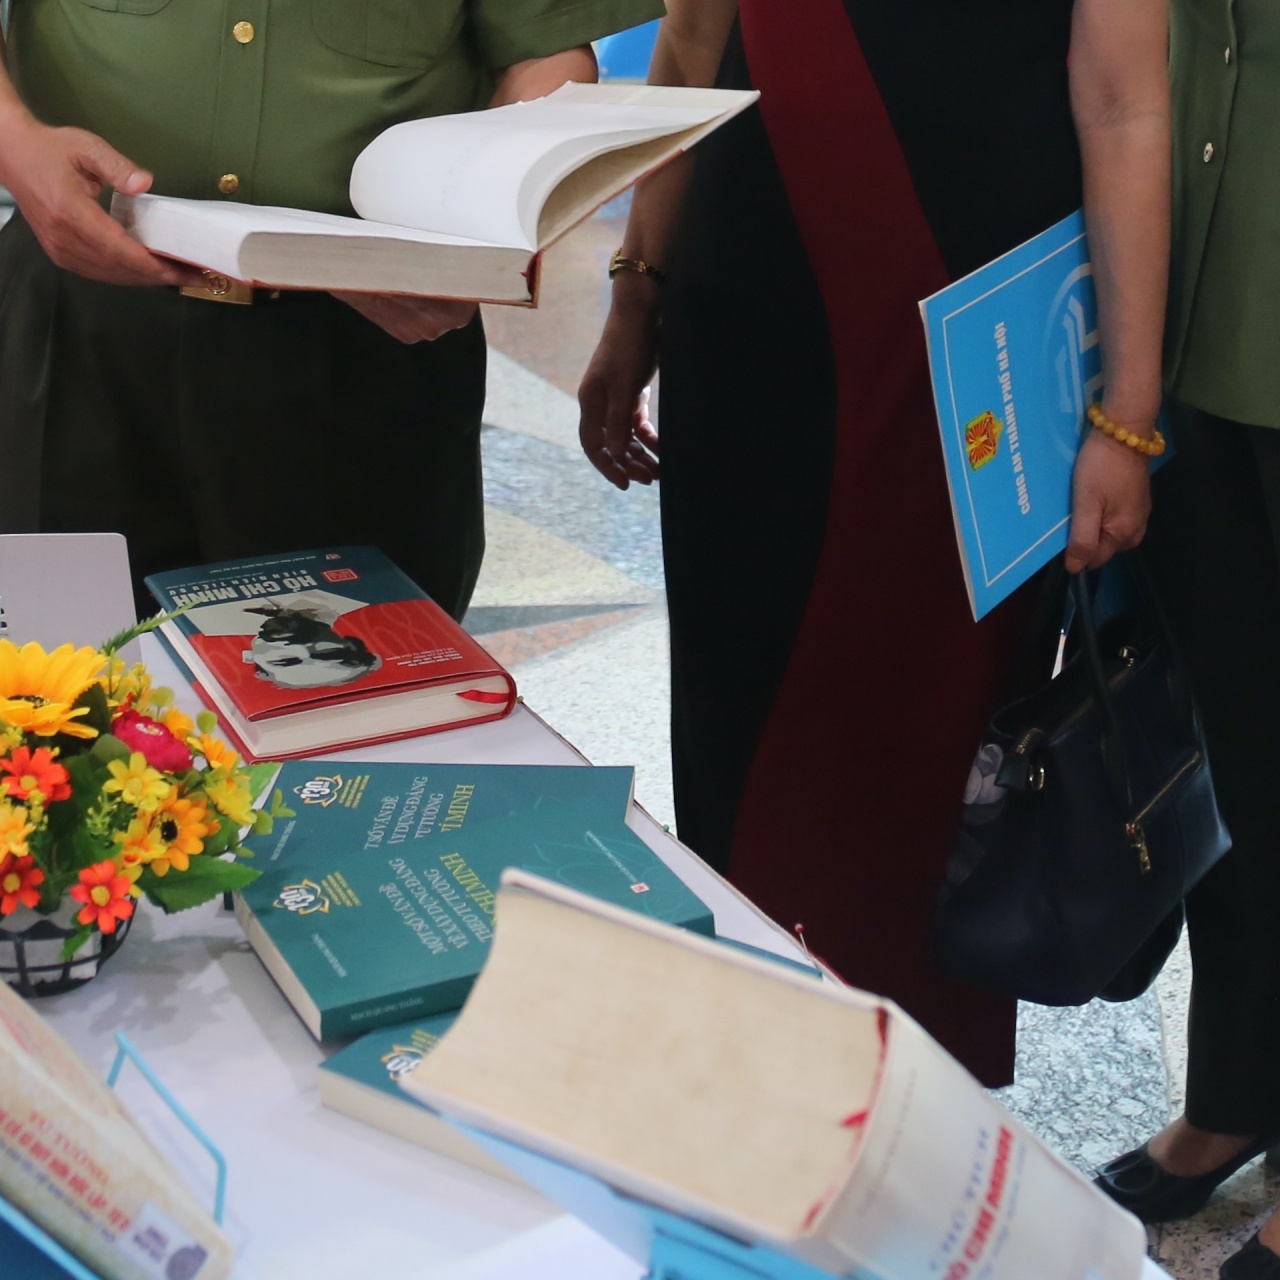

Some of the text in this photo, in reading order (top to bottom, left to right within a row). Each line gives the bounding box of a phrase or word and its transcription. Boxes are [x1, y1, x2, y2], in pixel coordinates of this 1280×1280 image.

[994, 321, 1031, 515] CÔNG AN THÀNH PHỐ HÀ NỘI
[242, 581, 281, 599] CHÍ
[284, 575, 318, 593] HỒ
[172, 588, 239, 607] MINH
[300, 780, 331, 799] 130
[445, 784, 475, 823] MINH
[440, 853, 486, 893] MINH
[280, 888, 315, 911] 130
